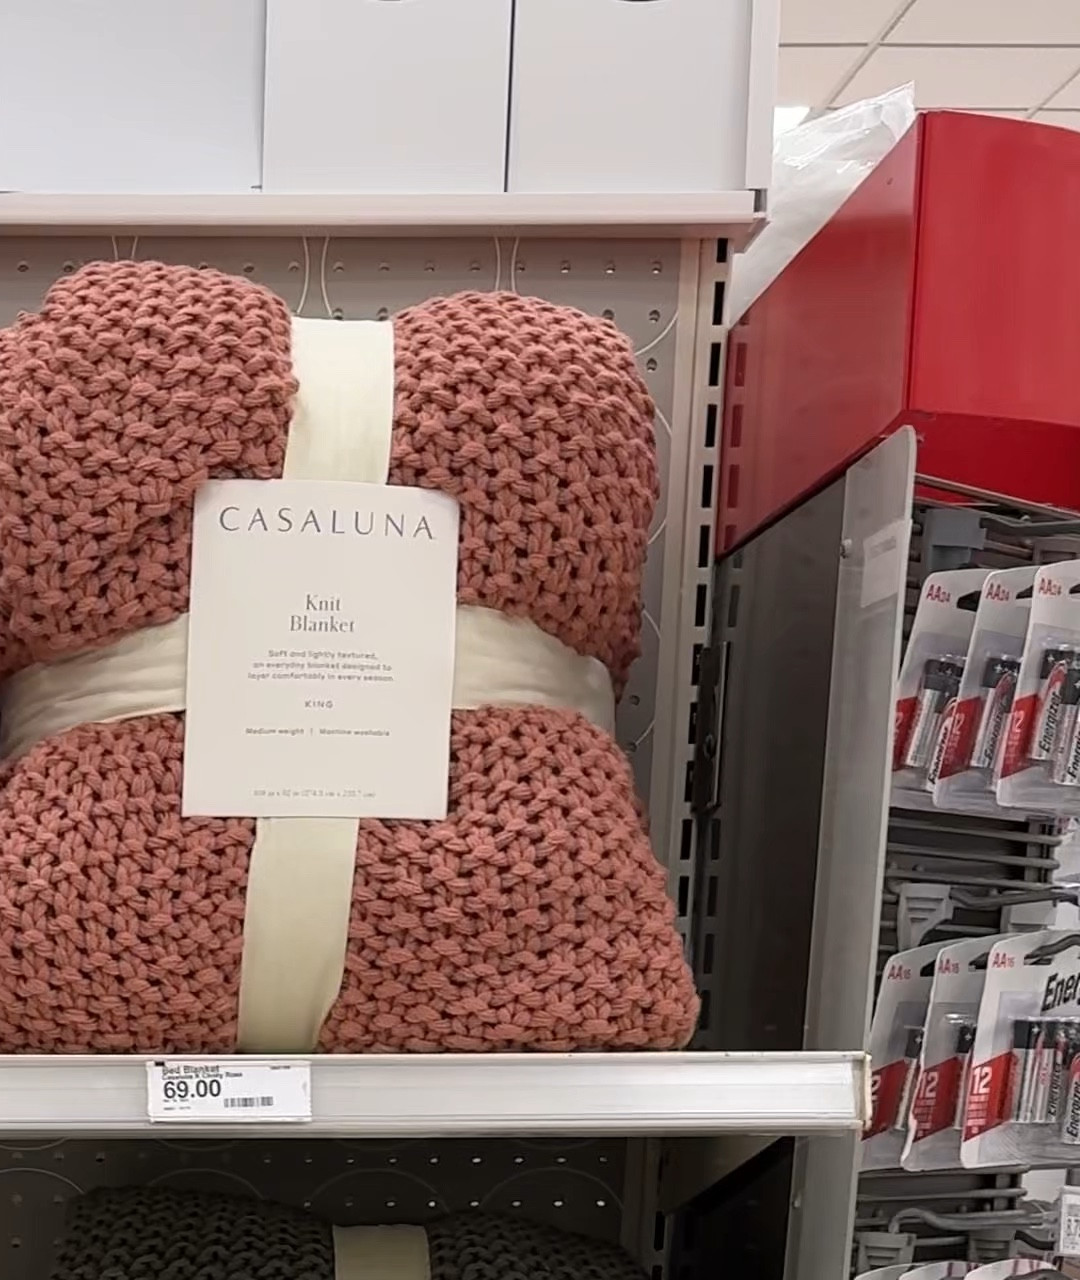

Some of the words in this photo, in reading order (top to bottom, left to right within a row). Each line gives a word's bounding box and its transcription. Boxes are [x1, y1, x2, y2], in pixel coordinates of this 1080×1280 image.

[219, 506, 435, 540] CASALUNA
[306, 594, 340, 611] Knit
[290, 615, 354, 632] Blanket
[304, 700, 333, 708] KING
[163, 1080, 221, 1098] 69.00
[920, 1071, 938, 1098] 12
[973, 1066, 992, 1094] 12
